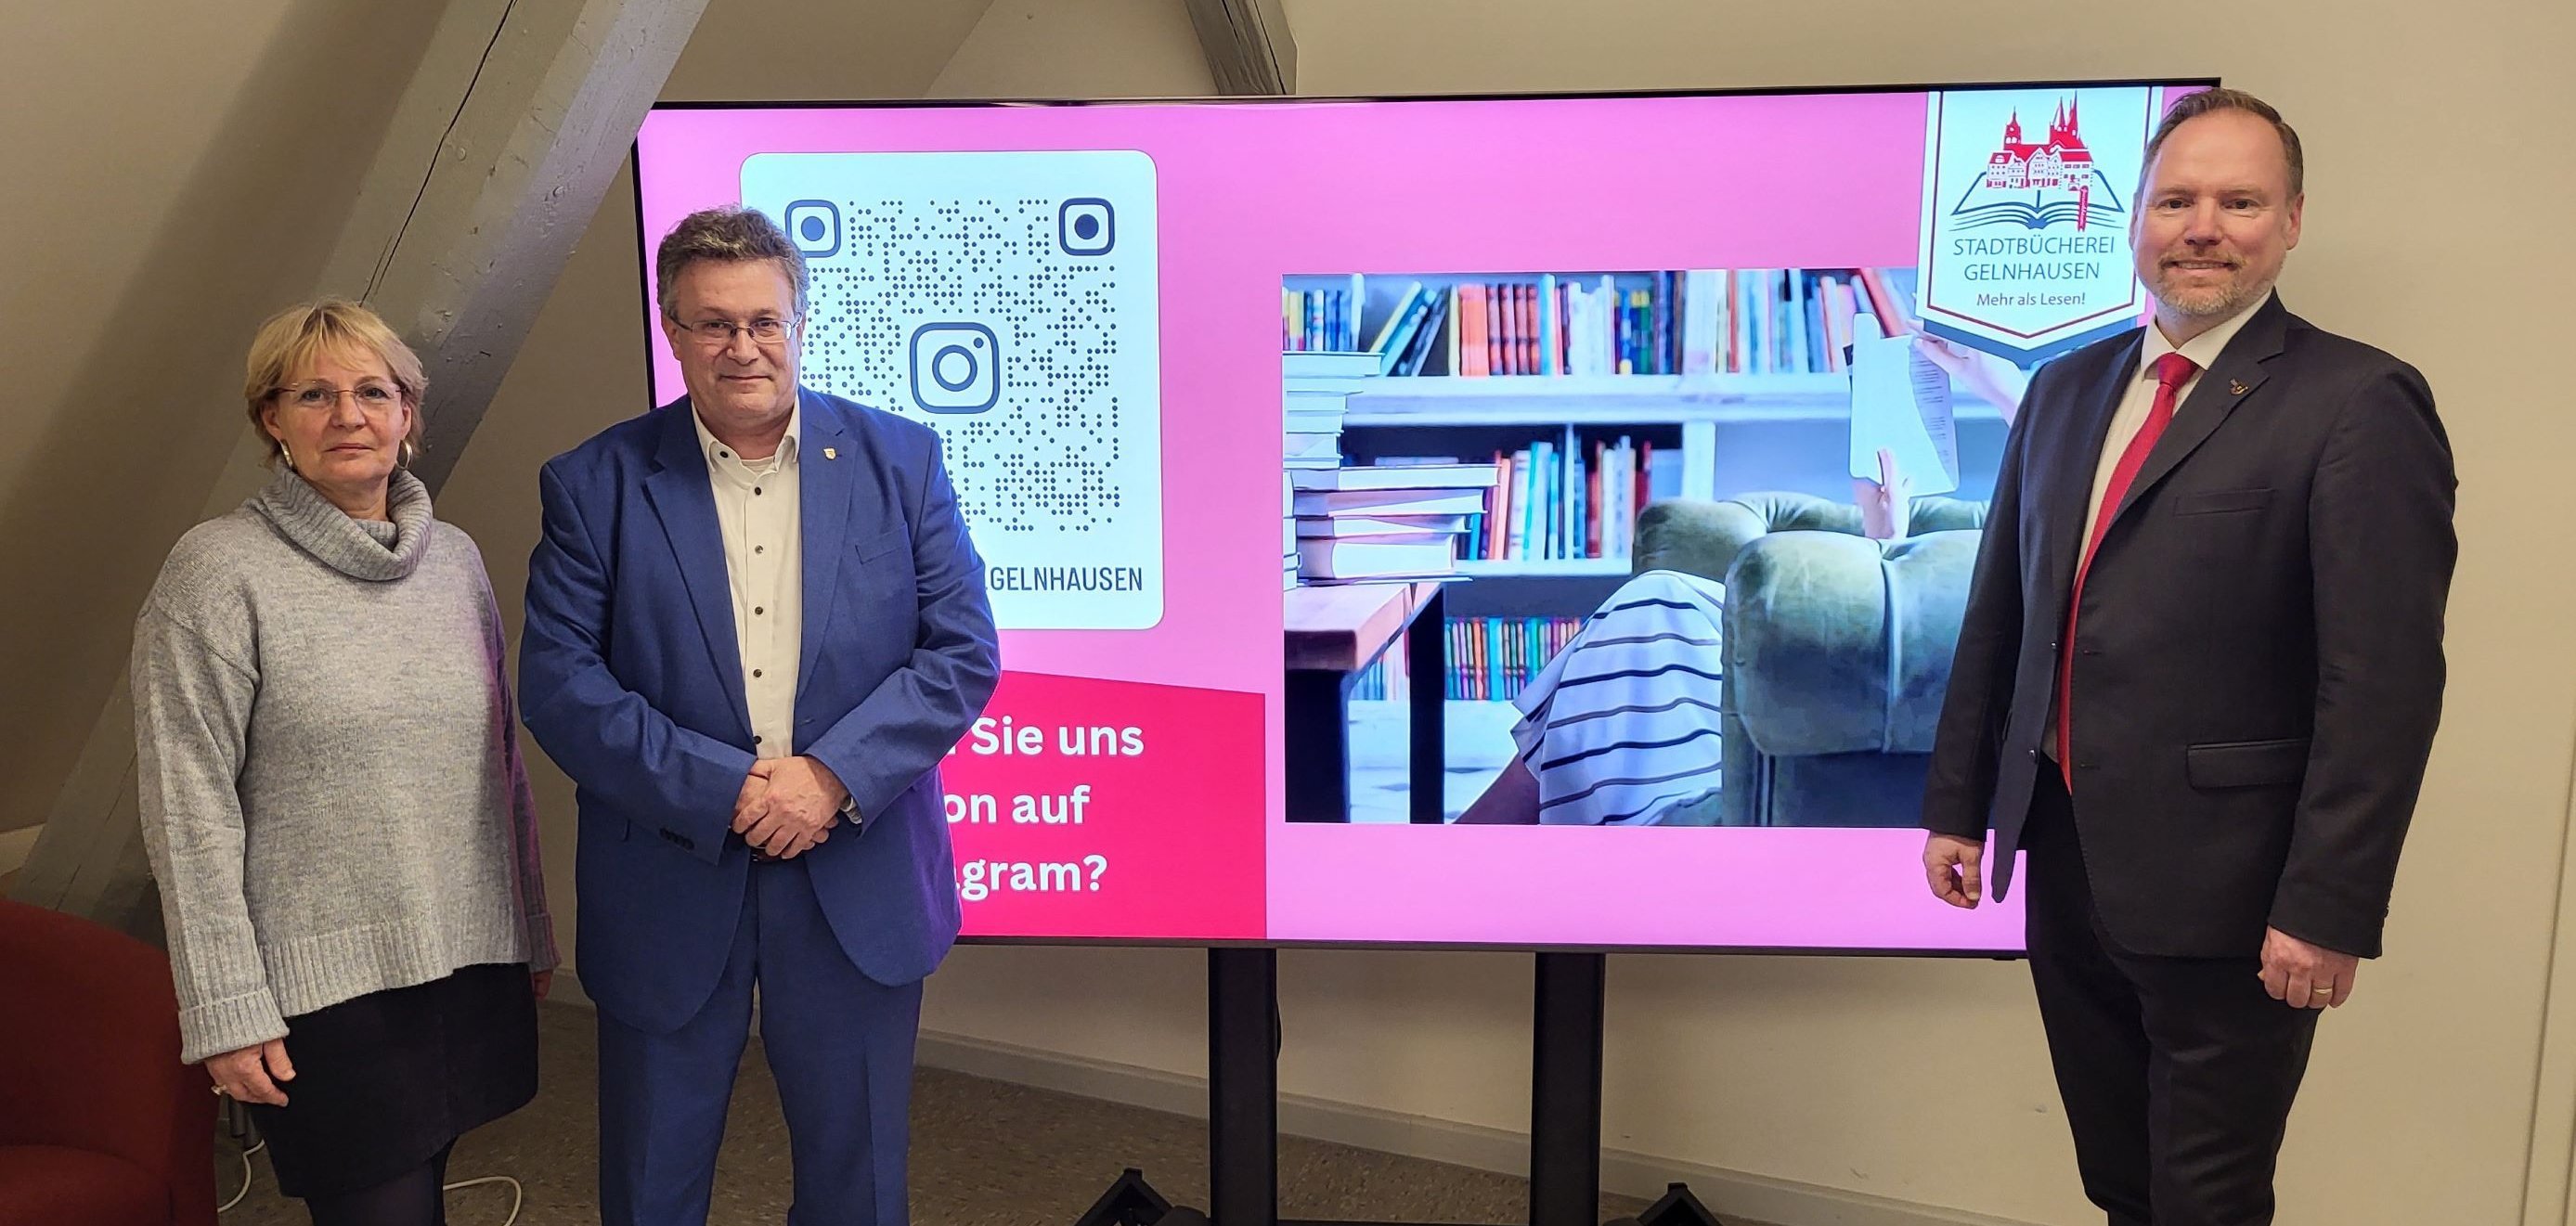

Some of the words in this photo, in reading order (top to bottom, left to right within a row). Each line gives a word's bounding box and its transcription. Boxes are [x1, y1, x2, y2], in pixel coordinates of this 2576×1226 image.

[1952, 234, 2115, 256] STADTBÜCHEREI
[1963, 262, 2101, 281] GELNHAUSEN
[1976, 292, 2014, 306] Mehr
[2017, 291, 2037, 306] als
[2040, 291, 2086, 306] Lesen!
[971, 716, 1043, 755] Sie
[1058, 726, 1145, 756] uns
[945, 794, 997, 823] on
[1012, 784, 1091, 824] auf
[955, 854, 1107, 901] gram?
